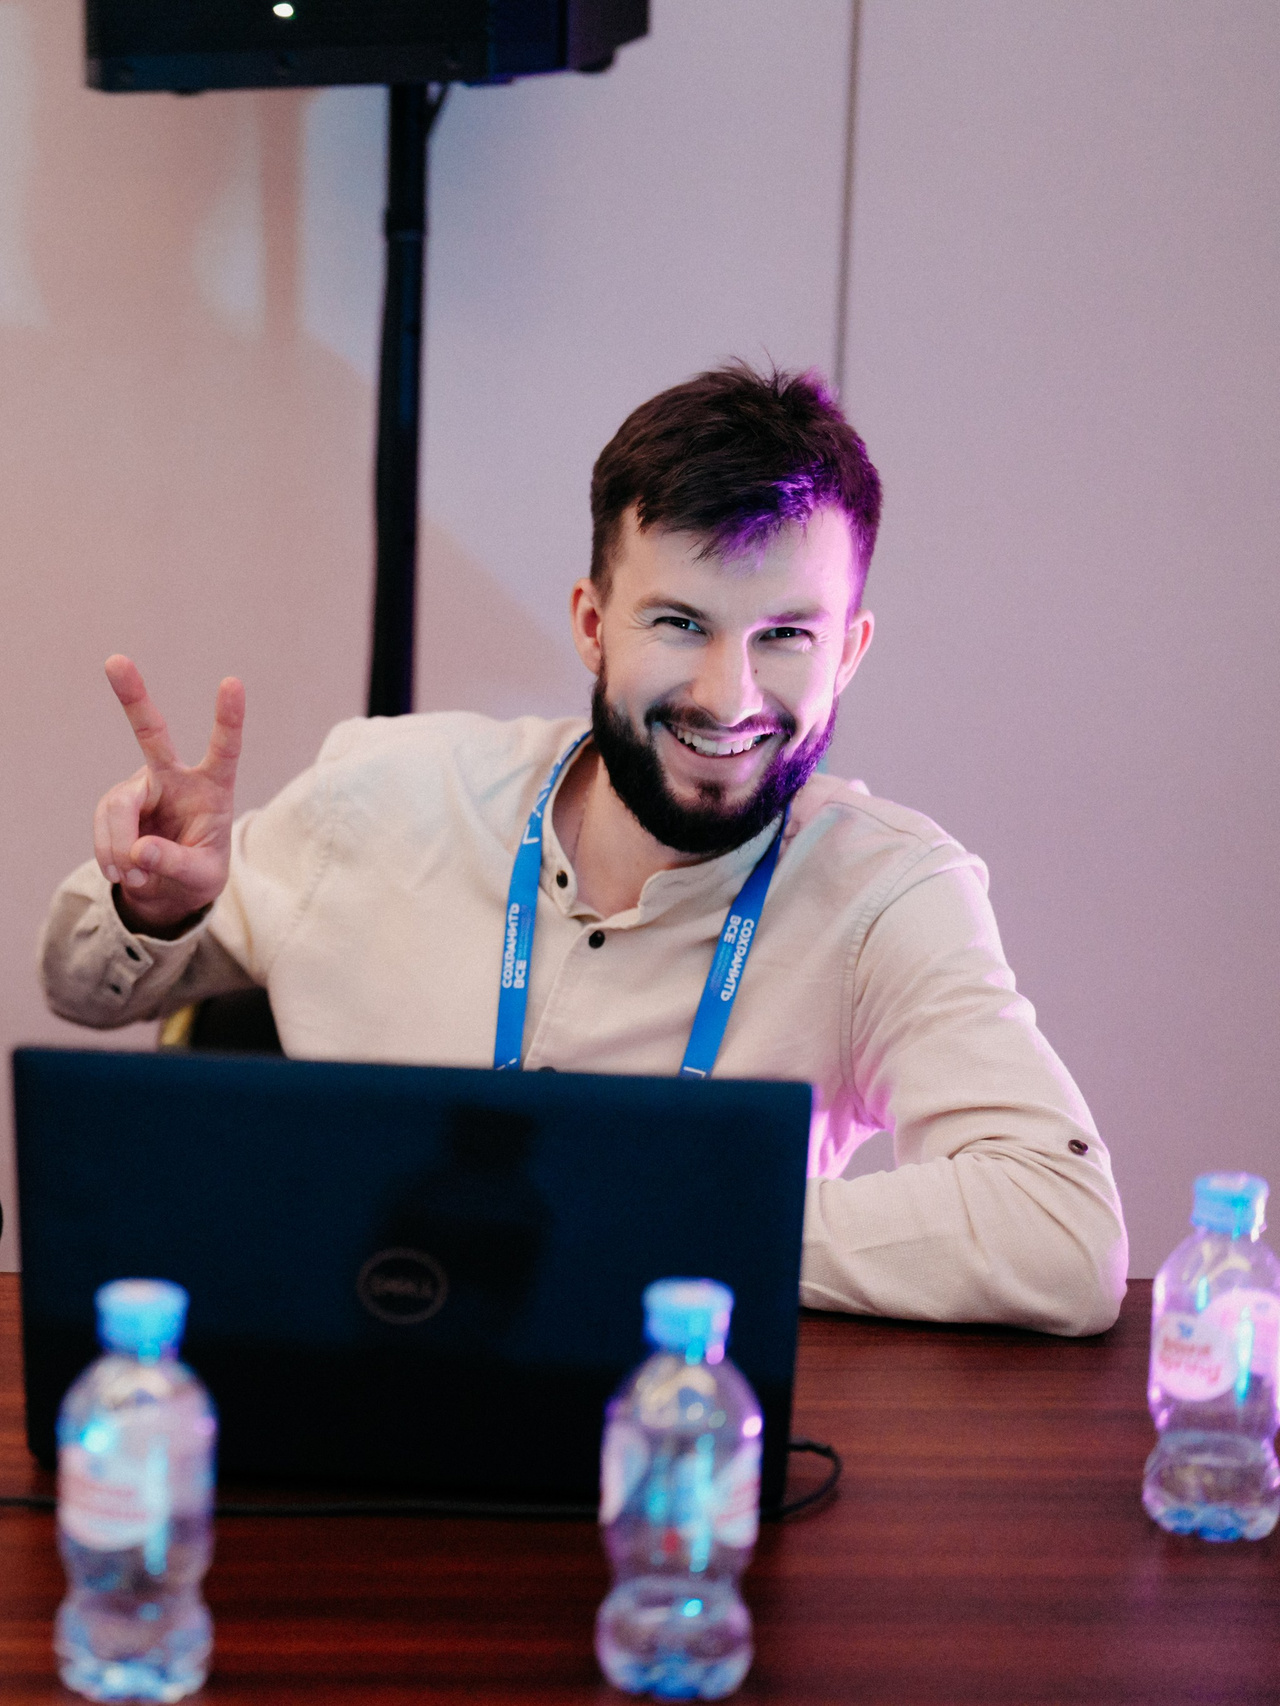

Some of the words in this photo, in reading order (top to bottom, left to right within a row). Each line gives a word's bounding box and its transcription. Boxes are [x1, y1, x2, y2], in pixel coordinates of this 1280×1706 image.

[502, 902, 521, 989] СОХРАНИТЬ
[723, 914, 743, 945] ВСЕ
[513, 959, 528, 989] ВСЕ
[720, 917, 755, 1002] СОХРАНИТЬ
